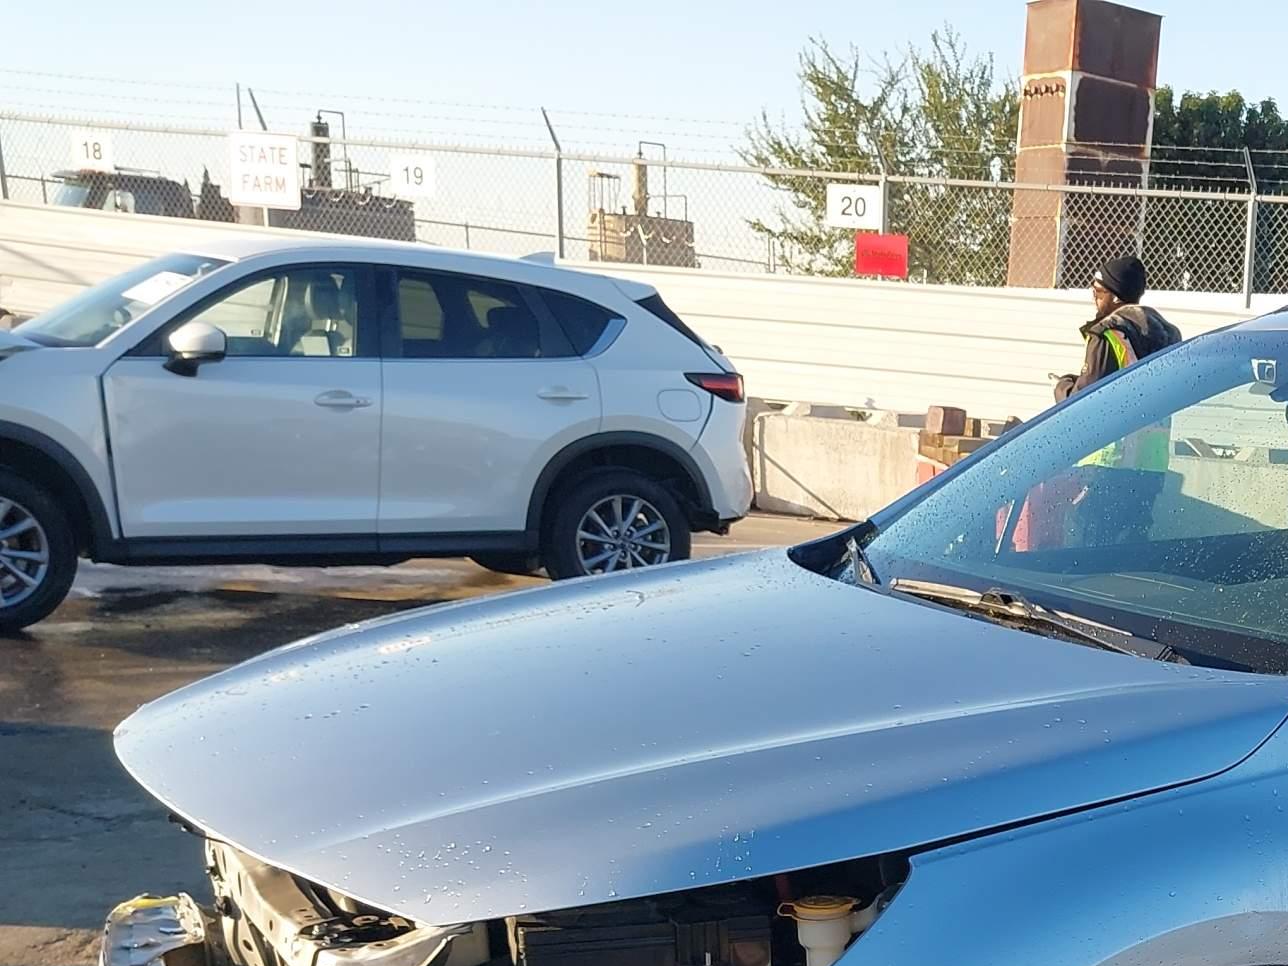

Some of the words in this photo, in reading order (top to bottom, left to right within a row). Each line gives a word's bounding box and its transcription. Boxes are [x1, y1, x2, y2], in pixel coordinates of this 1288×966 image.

[82, 140, 102, 161] 18
[239, 144, 288, 166] STATE
[242, 173, 287, 193] FARM
[402, 165, 424, 186] 19
[841, 195, 866, 217] 20
